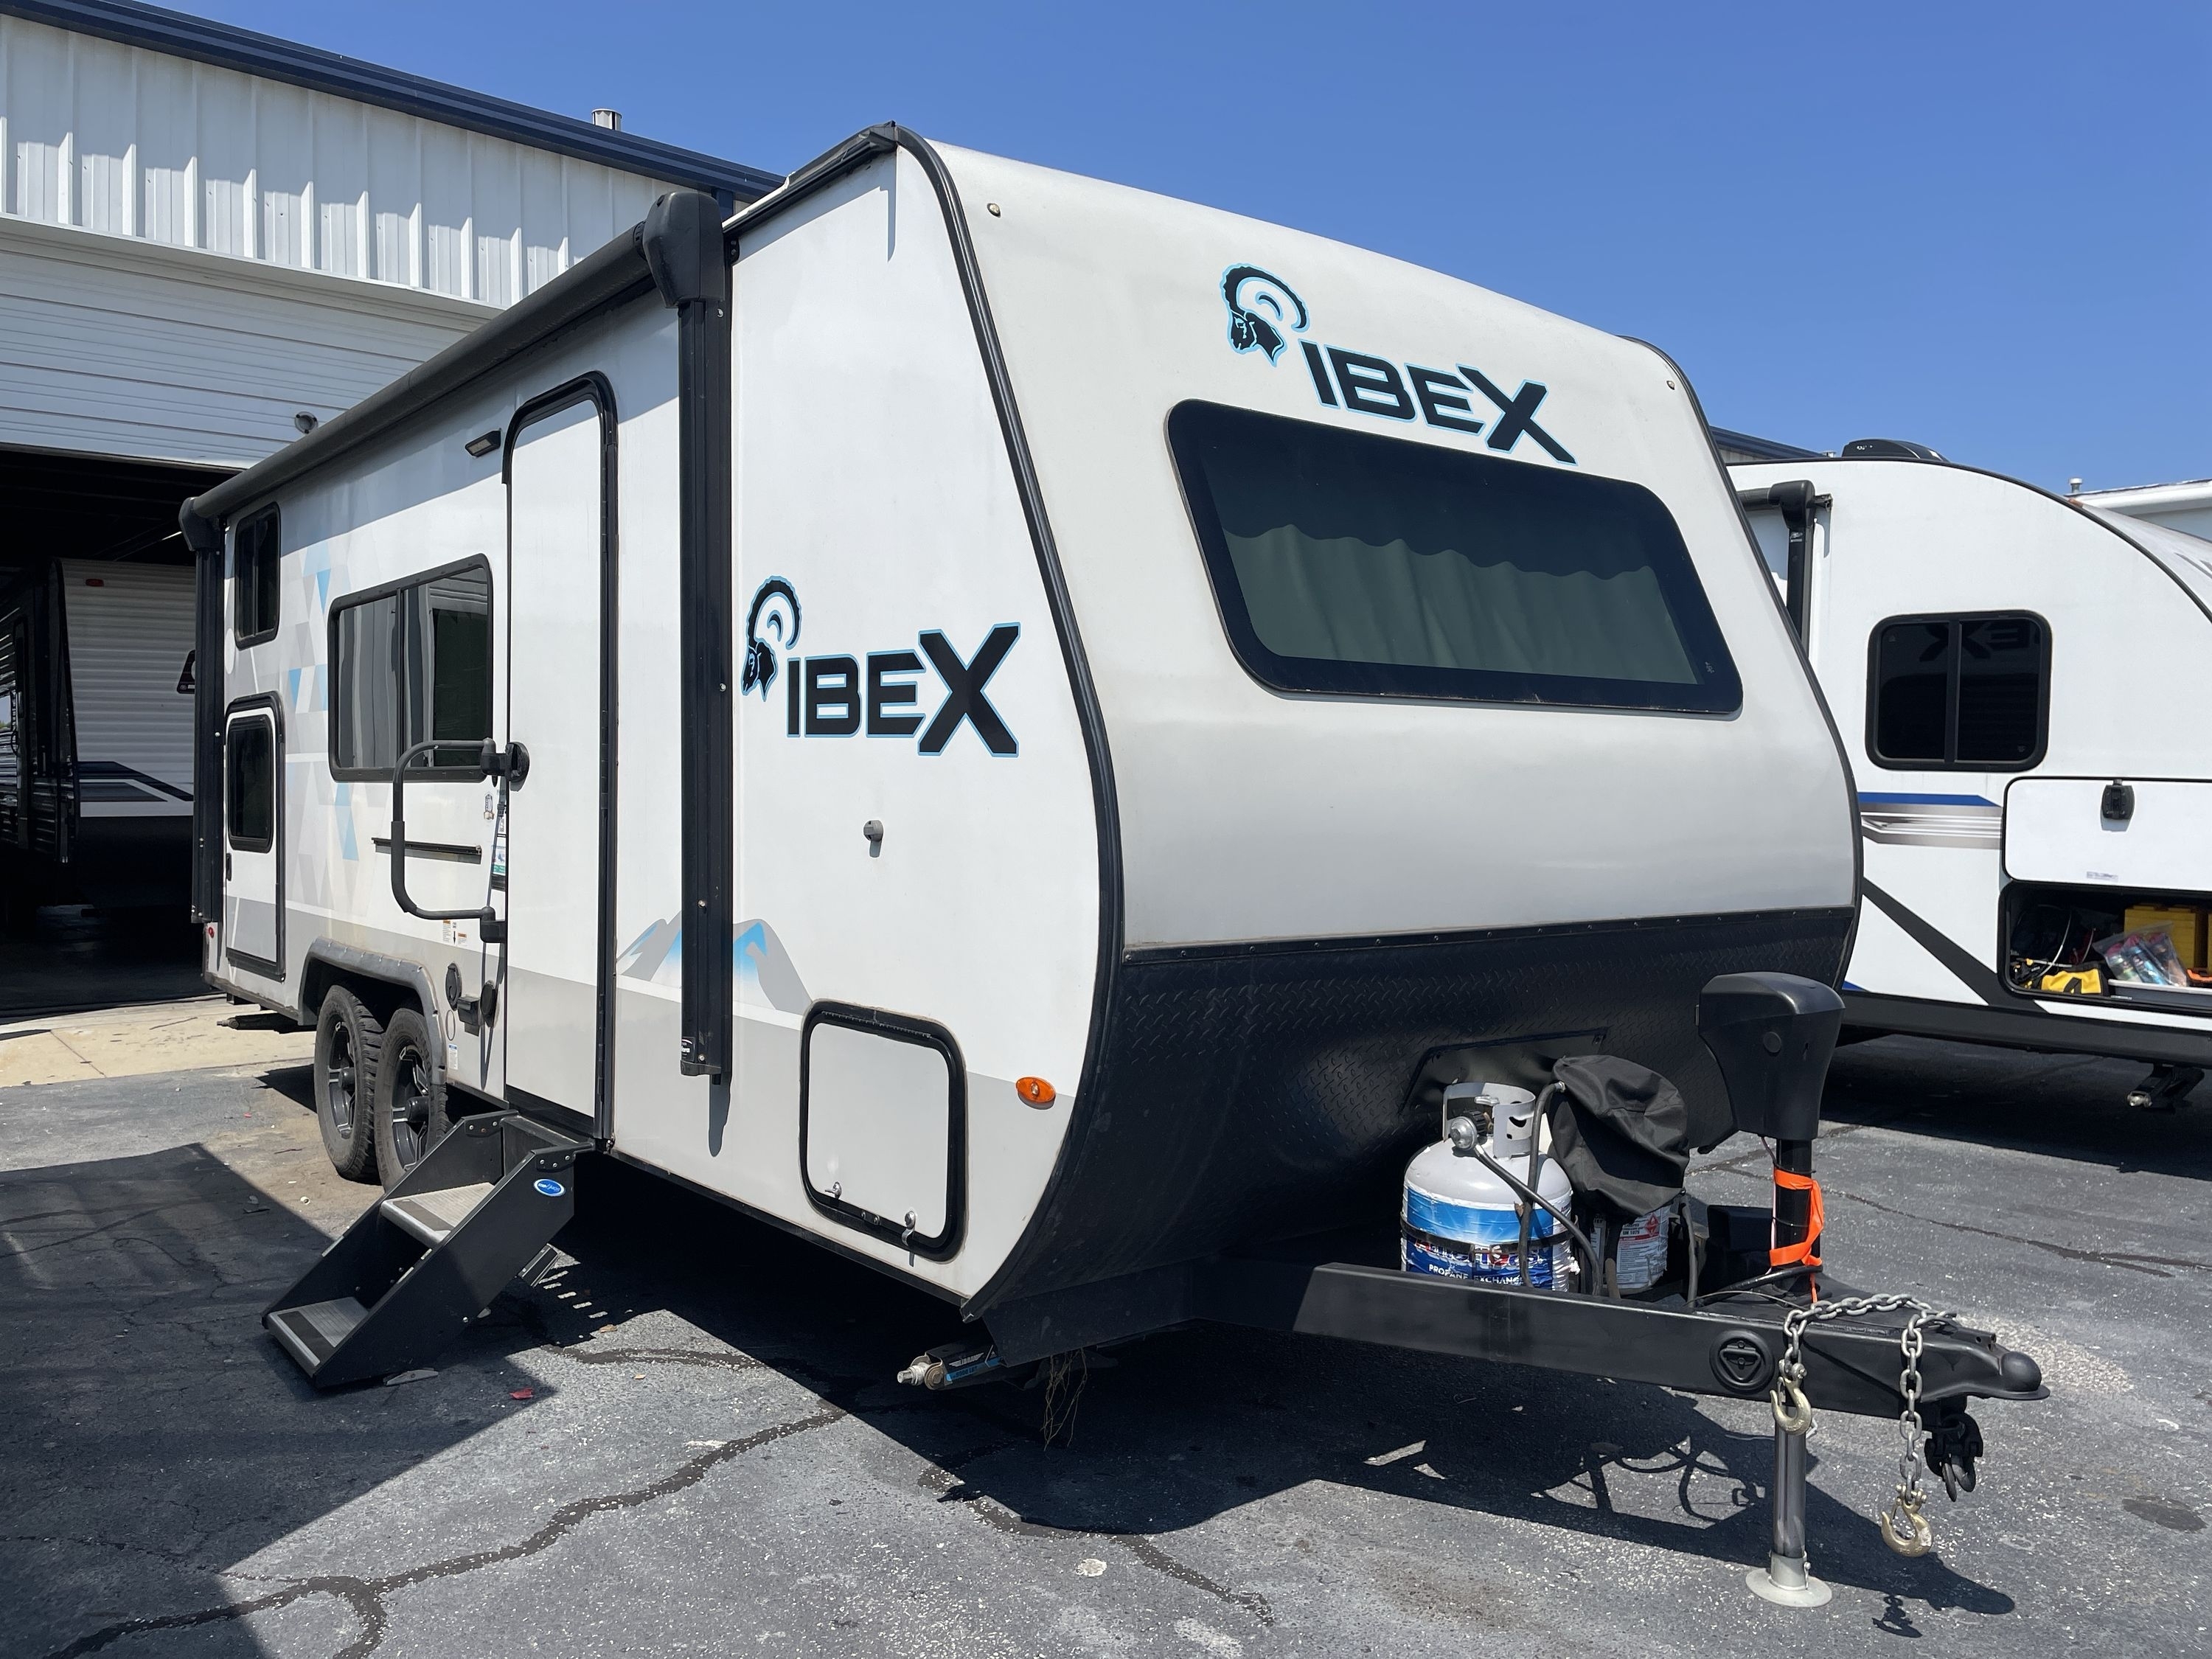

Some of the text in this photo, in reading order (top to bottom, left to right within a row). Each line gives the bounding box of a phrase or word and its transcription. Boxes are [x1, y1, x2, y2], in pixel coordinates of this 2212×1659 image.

[1297, 338, 1579, 466] IBEX
[786, 622, 1021, 758] IBEX
[1428, 1264, 1469, 1280] PROPANE
